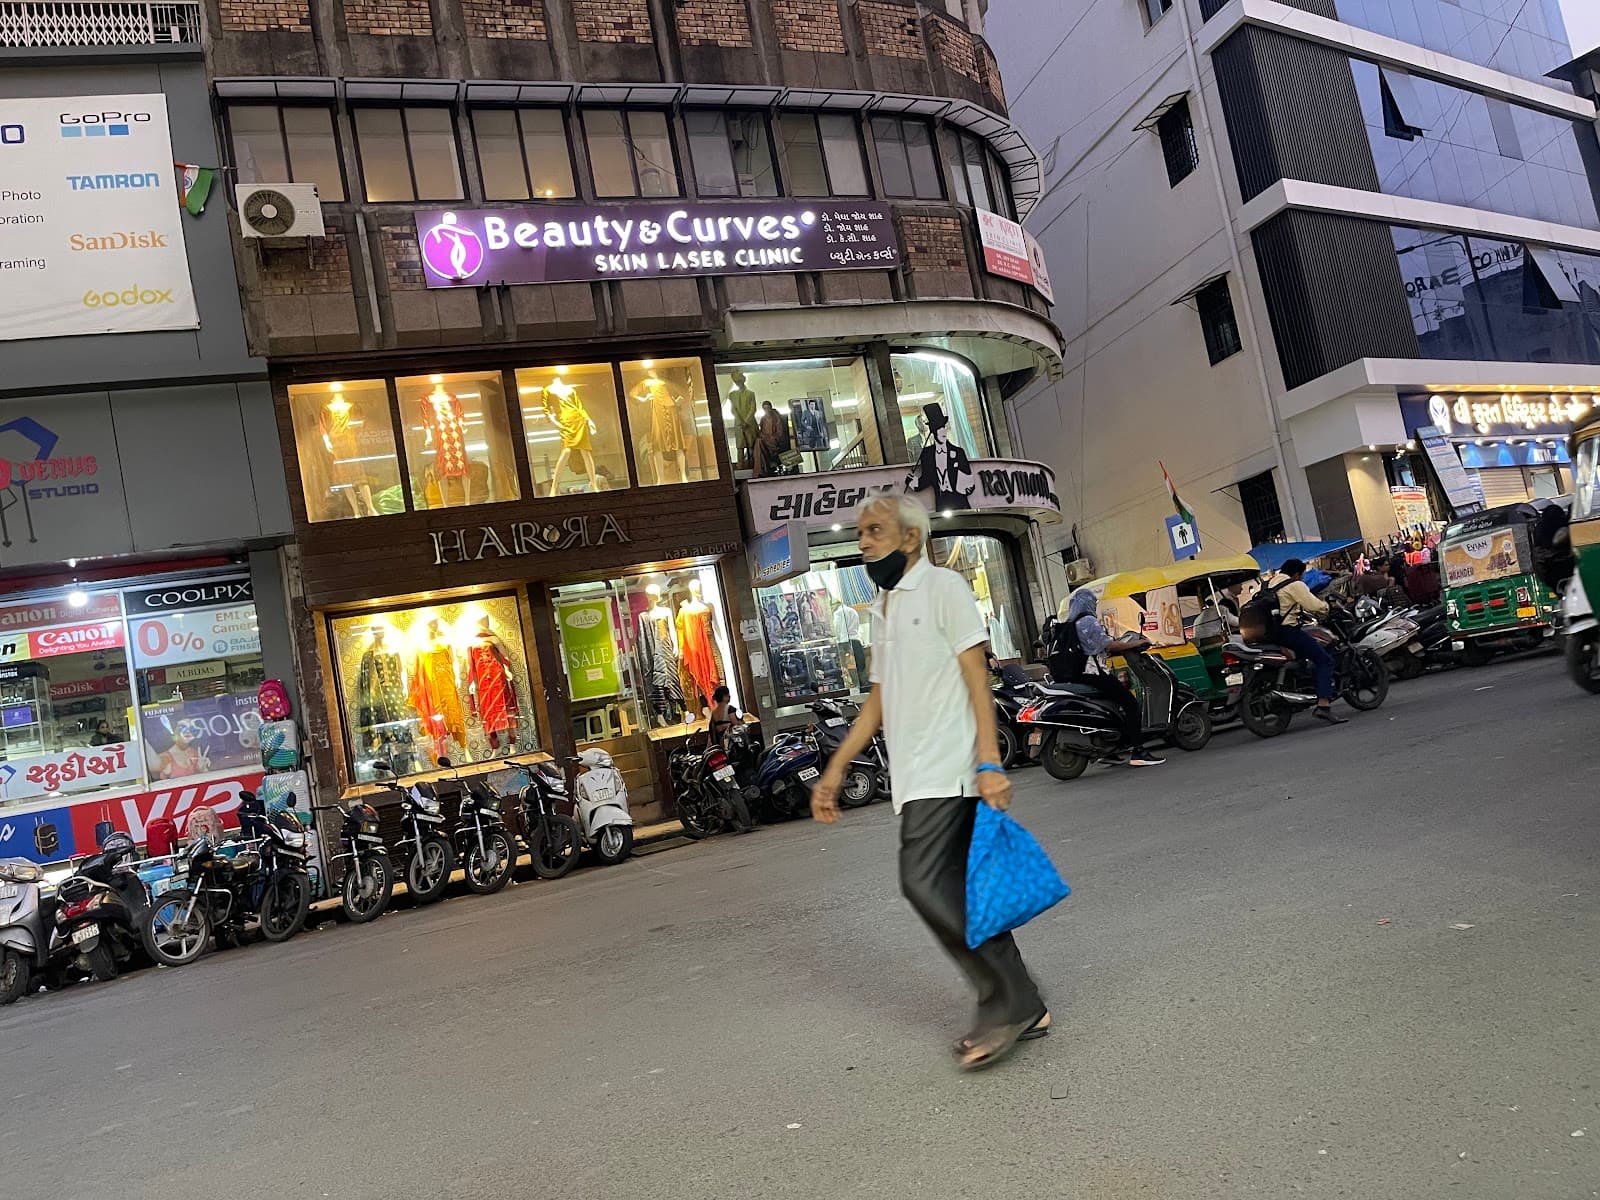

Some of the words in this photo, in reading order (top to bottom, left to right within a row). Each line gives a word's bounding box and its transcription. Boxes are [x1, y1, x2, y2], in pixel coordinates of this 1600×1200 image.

[59, 111, 151, 124] GoPro
[66, 172, 160, 190] TAMRON
[2, 190, 41, 201] Photo
[0, 213, 44, 225] oration
[483, 216, 633, 251] Beauty
[667, 210, 801, 243] Curves
[70, 230, 168, 251] SanDisk
[0, 257, 46, 270] raming
[595, 251, 649, 273] SKIN
[659, 249, 728, 270] LASER
[735, 246, 804, 267] CLINIC
[28, 483, 99, 500] STUDIO
[145, 581, 250, 608] COOLPIX
[1, 607, 56, 625] anon
[215, 611, 240, 622] EMI
[38, 626, 116, 647] Canon
[138, 620, 205, 657] 0%
[570, 646, 611, 669] SALE
[50, 682, 94, 696] SanDisk
[235, 695, 258, 706] insta
